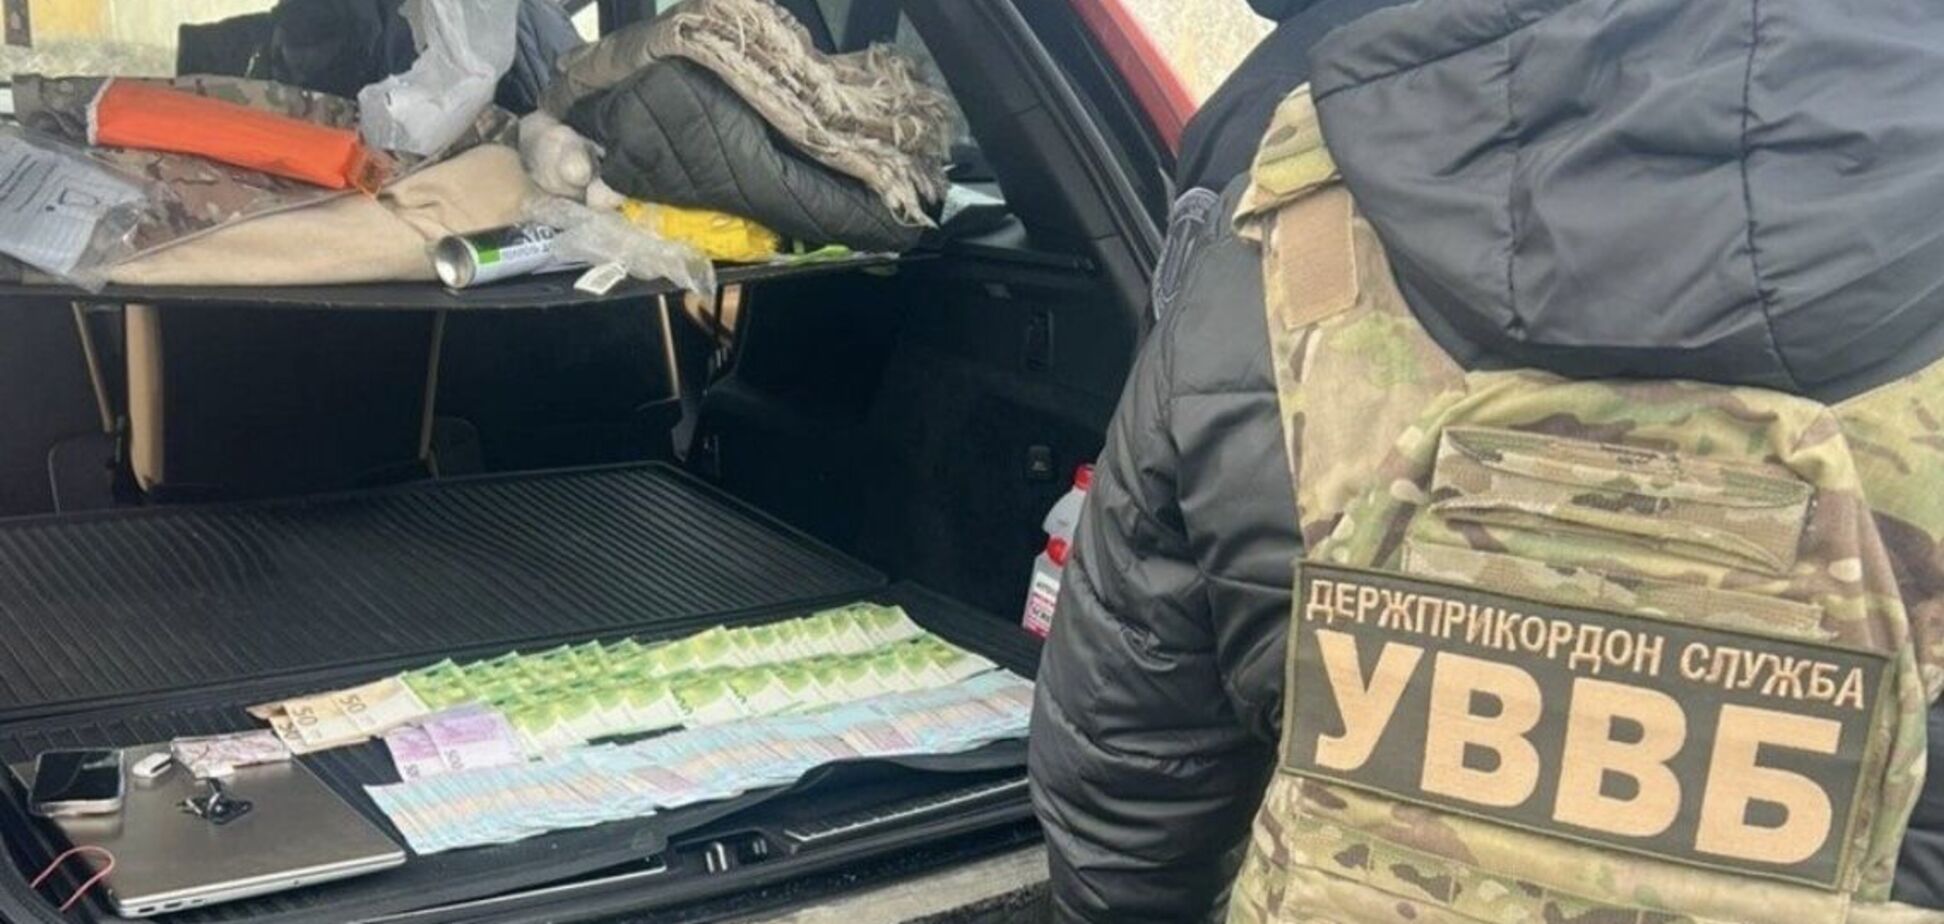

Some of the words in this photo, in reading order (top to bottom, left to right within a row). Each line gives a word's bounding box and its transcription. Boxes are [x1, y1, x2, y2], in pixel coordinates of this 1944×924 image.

[1305, 579, 1665, 677] ДЕРЖПРИКОРДОН
[1679, 642, 1865, 710] СЛУЖБА
[292, 706, 319, 727] 50
[339, 694, 367, 714] 50
[1314, 628, 1843, 865] УВВБ
